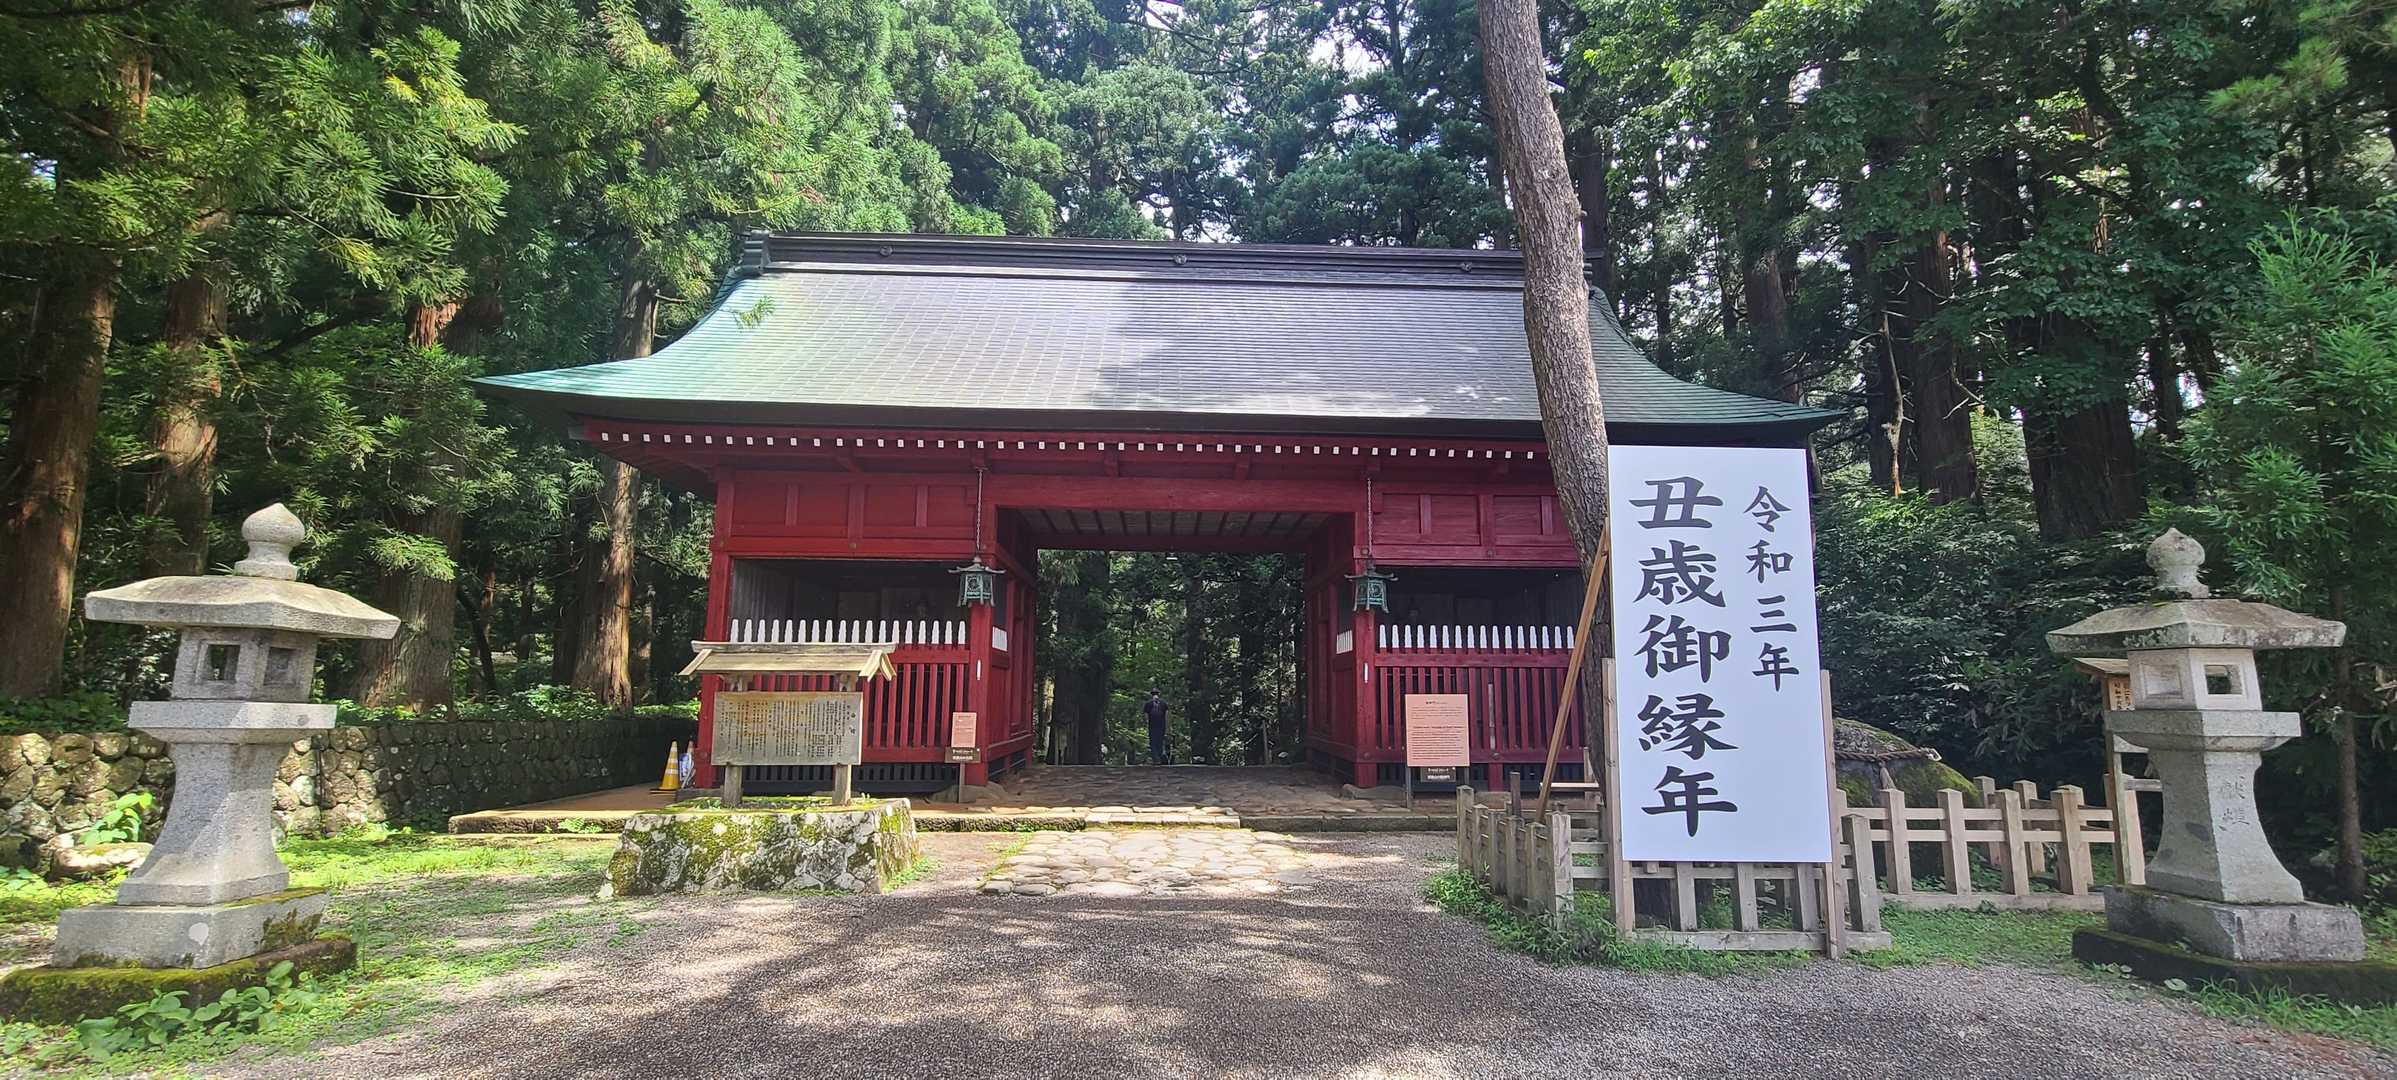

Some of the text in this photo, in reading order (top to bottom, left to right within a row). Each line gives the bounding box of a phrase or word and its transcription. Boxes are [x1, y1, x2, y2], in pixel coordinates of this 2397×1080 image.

[1628, 476, 1739, 838] 丑歳御縁年
[1743, 485, 1800, 692] 令和三年
